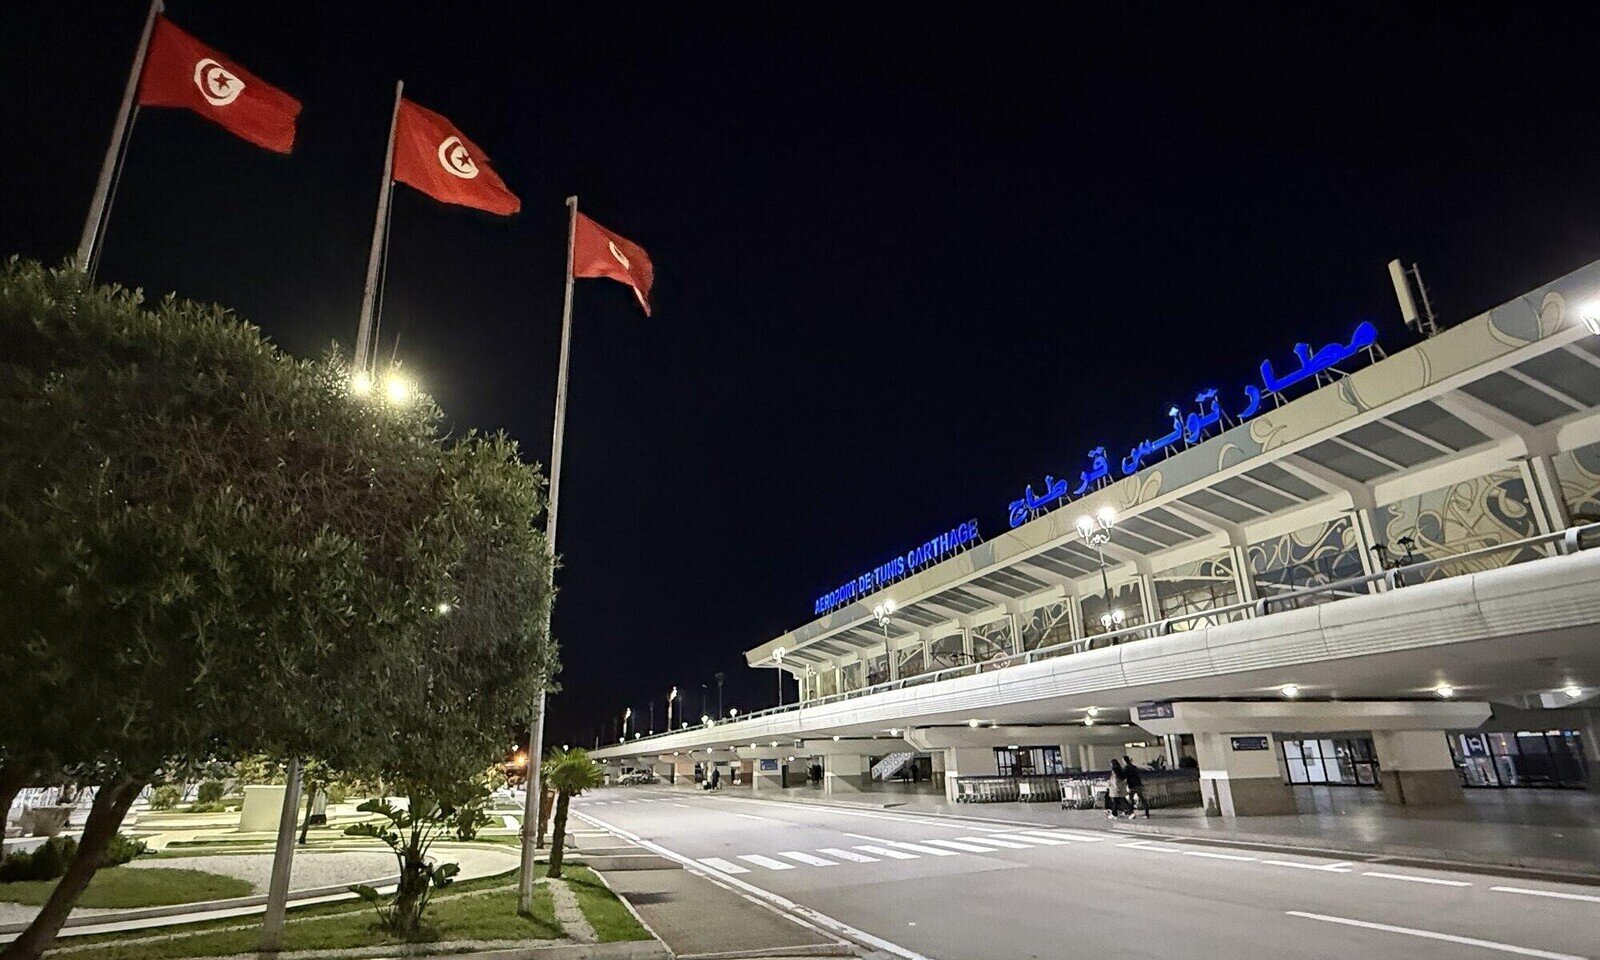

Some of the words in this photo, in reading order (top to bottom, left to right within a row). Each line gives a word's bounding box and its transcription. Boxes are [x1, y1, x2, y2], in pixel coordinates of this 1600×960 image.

[1237, 321, 1379, 418] مطار
[1122, 388, 1221, 474] تونس
[1008, 446, 1108, 528] قرطاج
[814, 580, 856, 615] AEROPORT
[858, 573, 872, 593] DE
[873, 556, 905, 585] TUNIS
[907, 518, 979, 568] CARTHAGE
